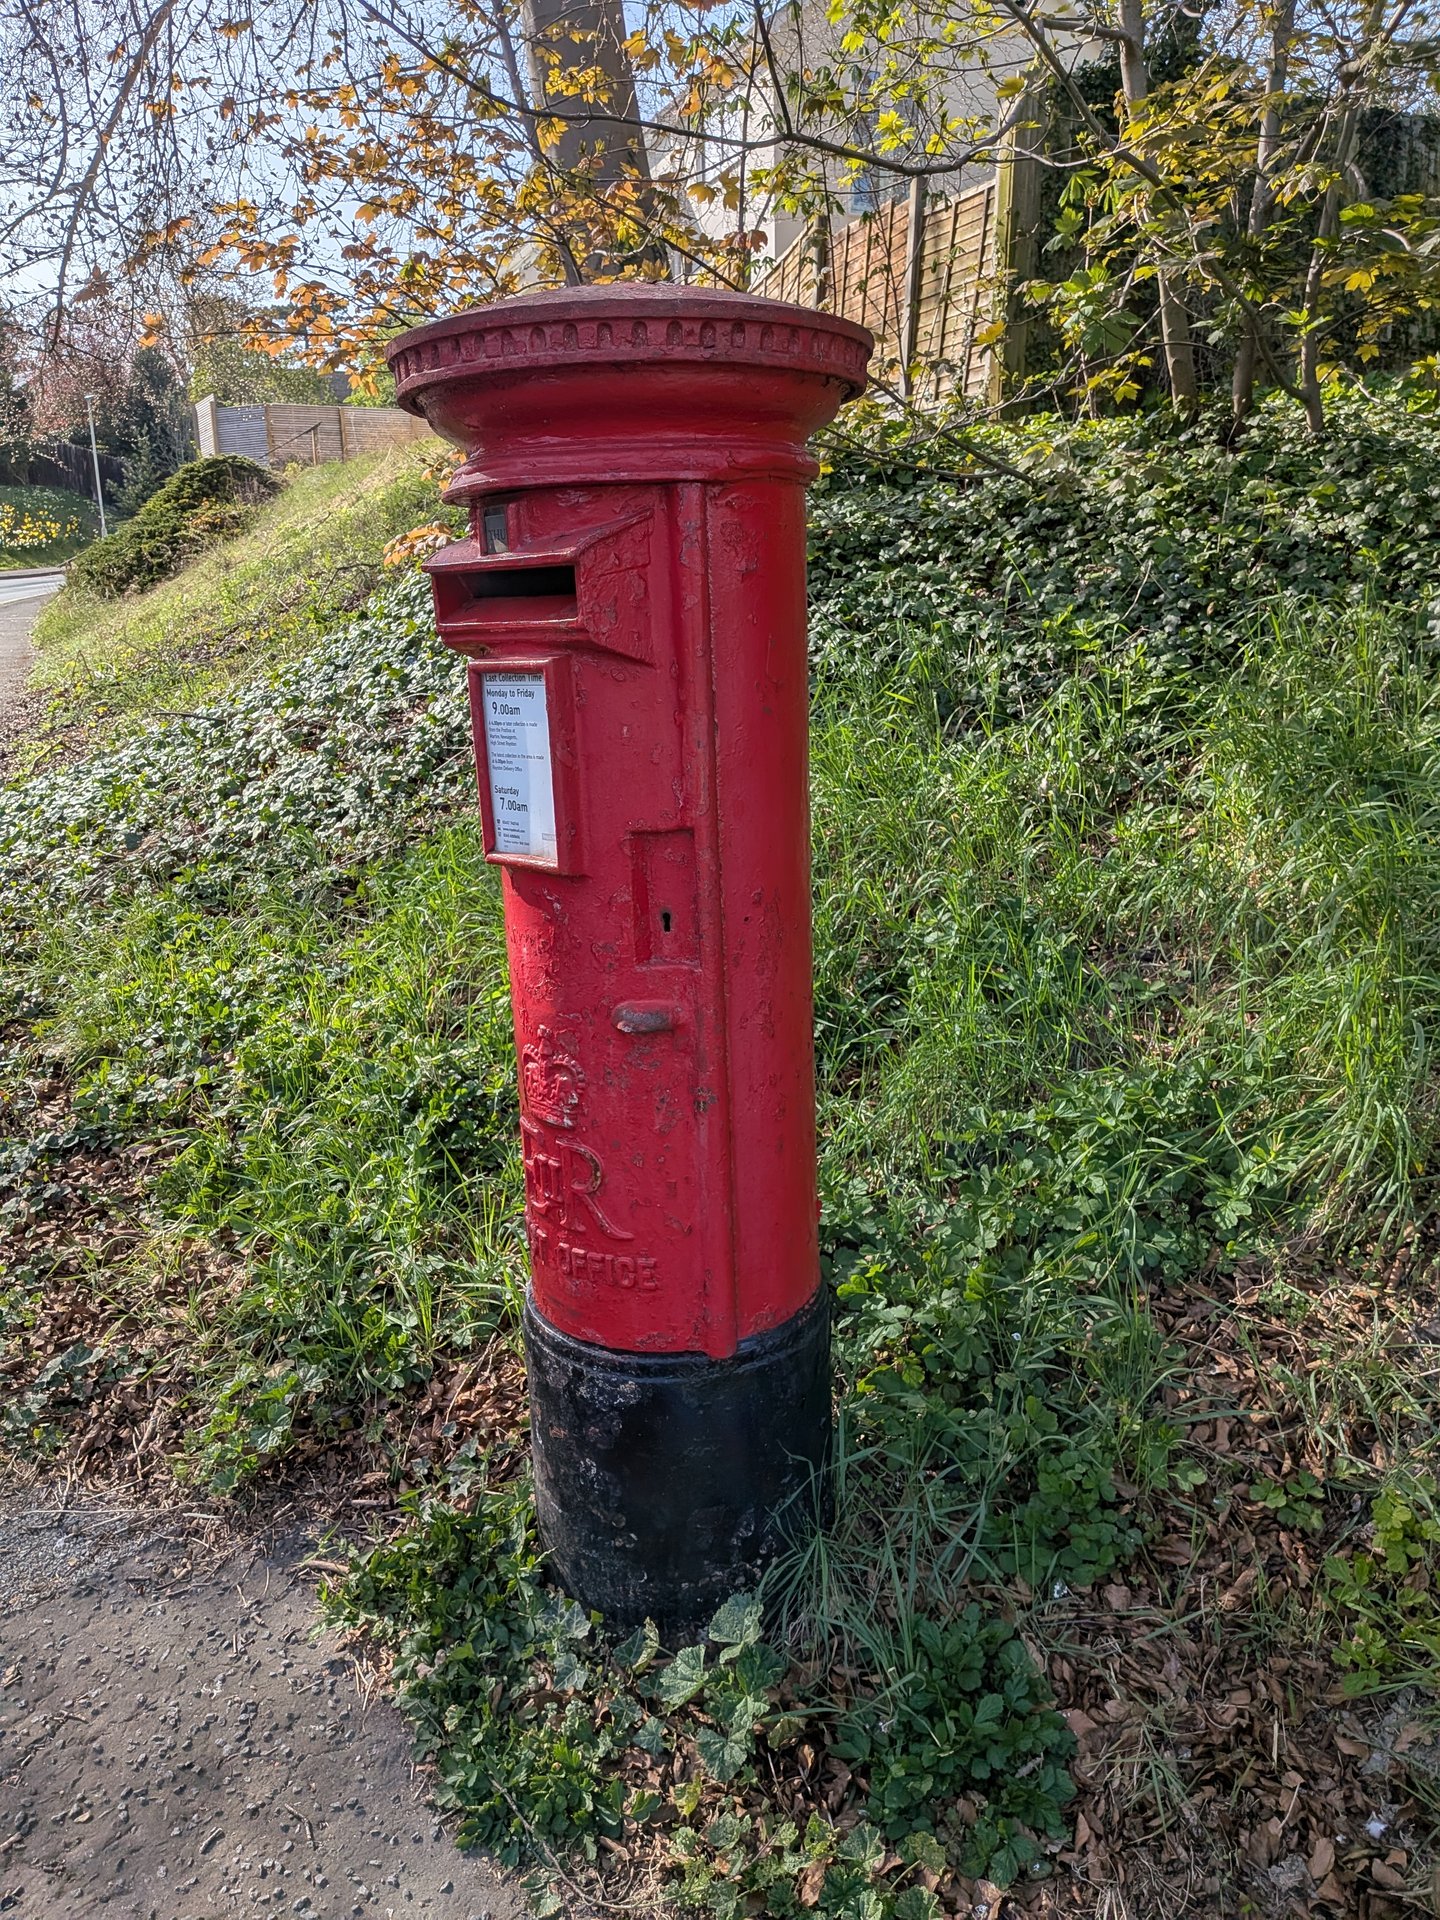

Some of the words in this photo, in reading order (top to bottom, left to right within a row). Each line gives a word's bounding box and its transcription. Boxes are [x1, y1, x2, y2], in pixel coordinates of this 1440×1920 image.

[485, 672, 497, 682] Last
[499, 672, 526, 682] Collection
[486, 688, 508, 700] Monday
[509, 690, 516, 698] to
[516, 688, 535, 700] Friday
[492, 701, 521, 716] 9.00am
[494, 784, 520, 797] Saturday
[499, 796, 528, 812] 7.00am
[555, 1241, 659, 1291] OFFICE
